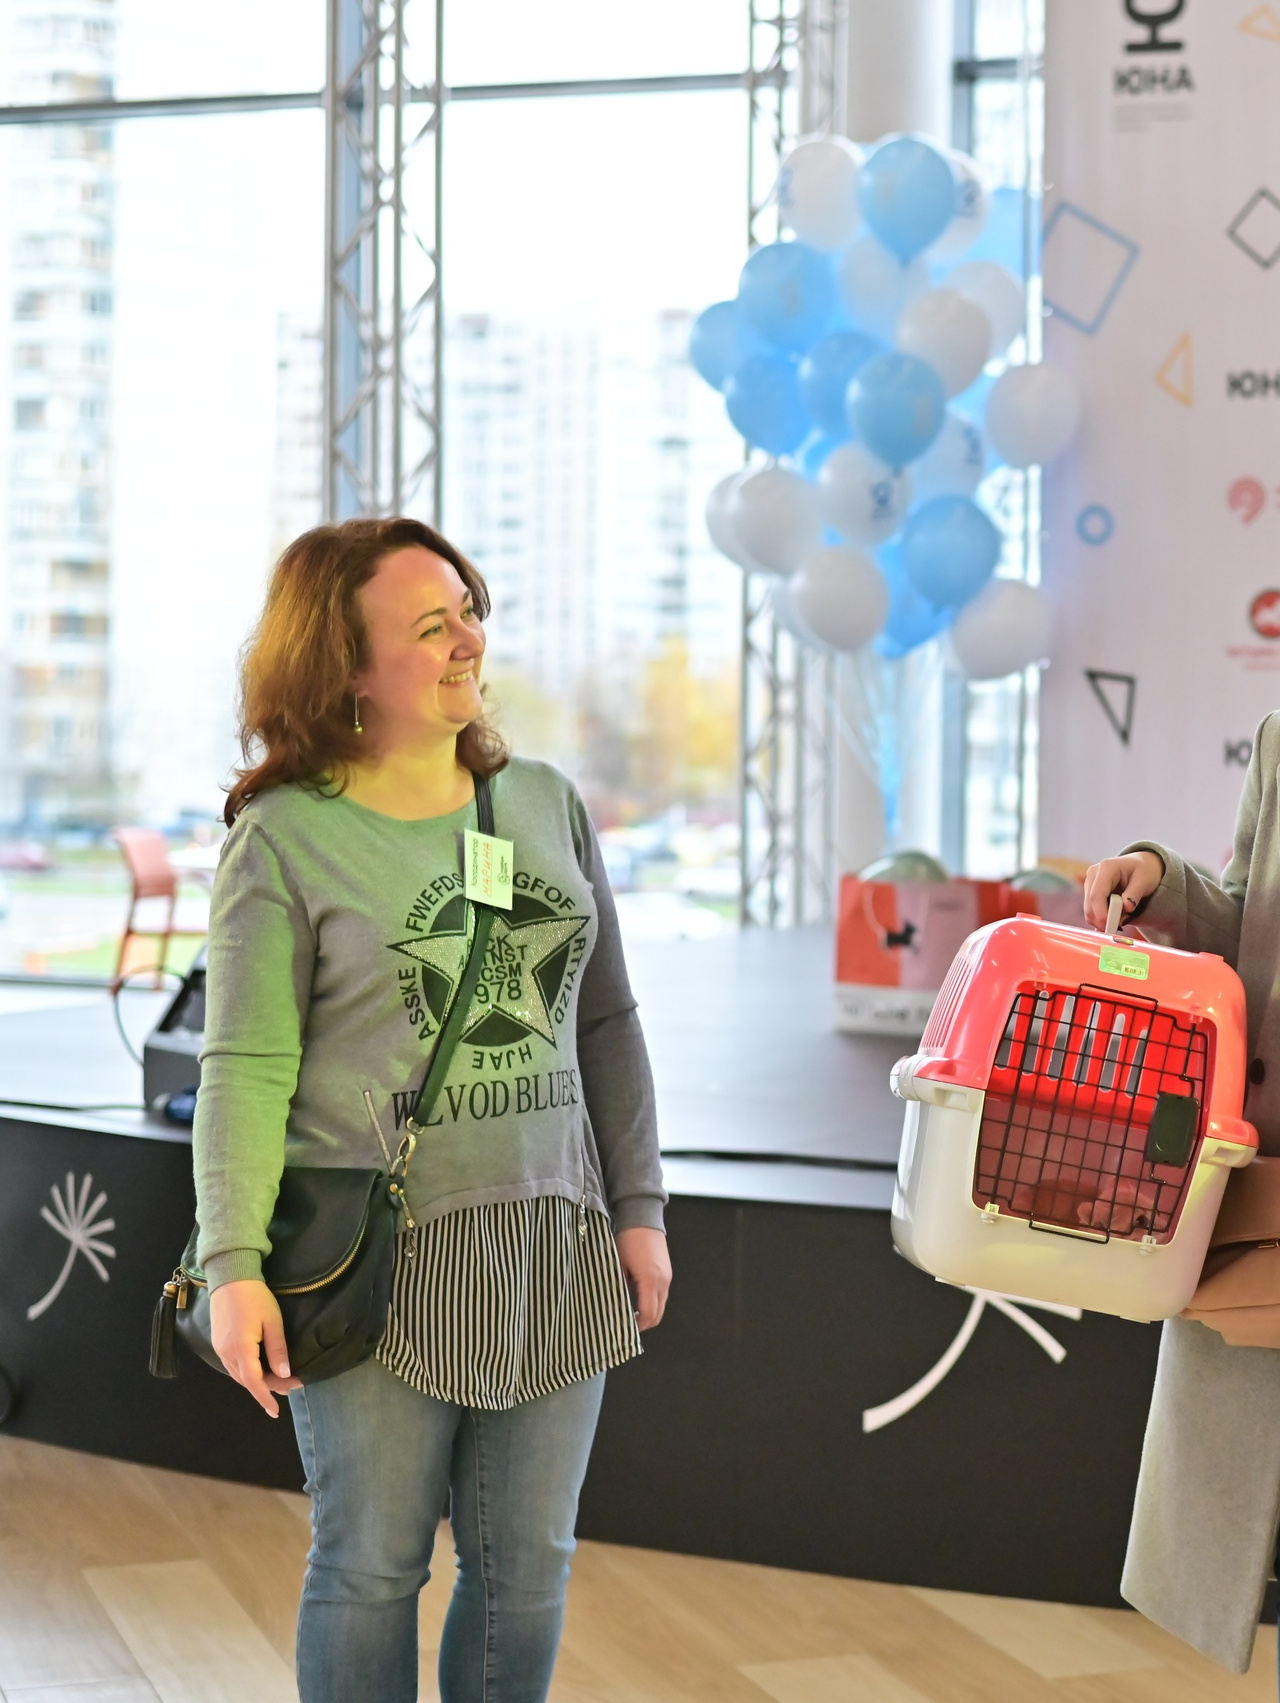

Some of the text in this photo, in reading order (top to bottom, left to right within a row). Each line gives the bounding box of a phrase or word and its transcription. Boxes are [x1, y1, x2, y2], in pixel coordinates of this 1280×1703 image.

[1113, 66, 1195, 96] ЮНА
[470, 837, 479, 887] Координатор
[481, 842, 493, 897] МАРИНА
